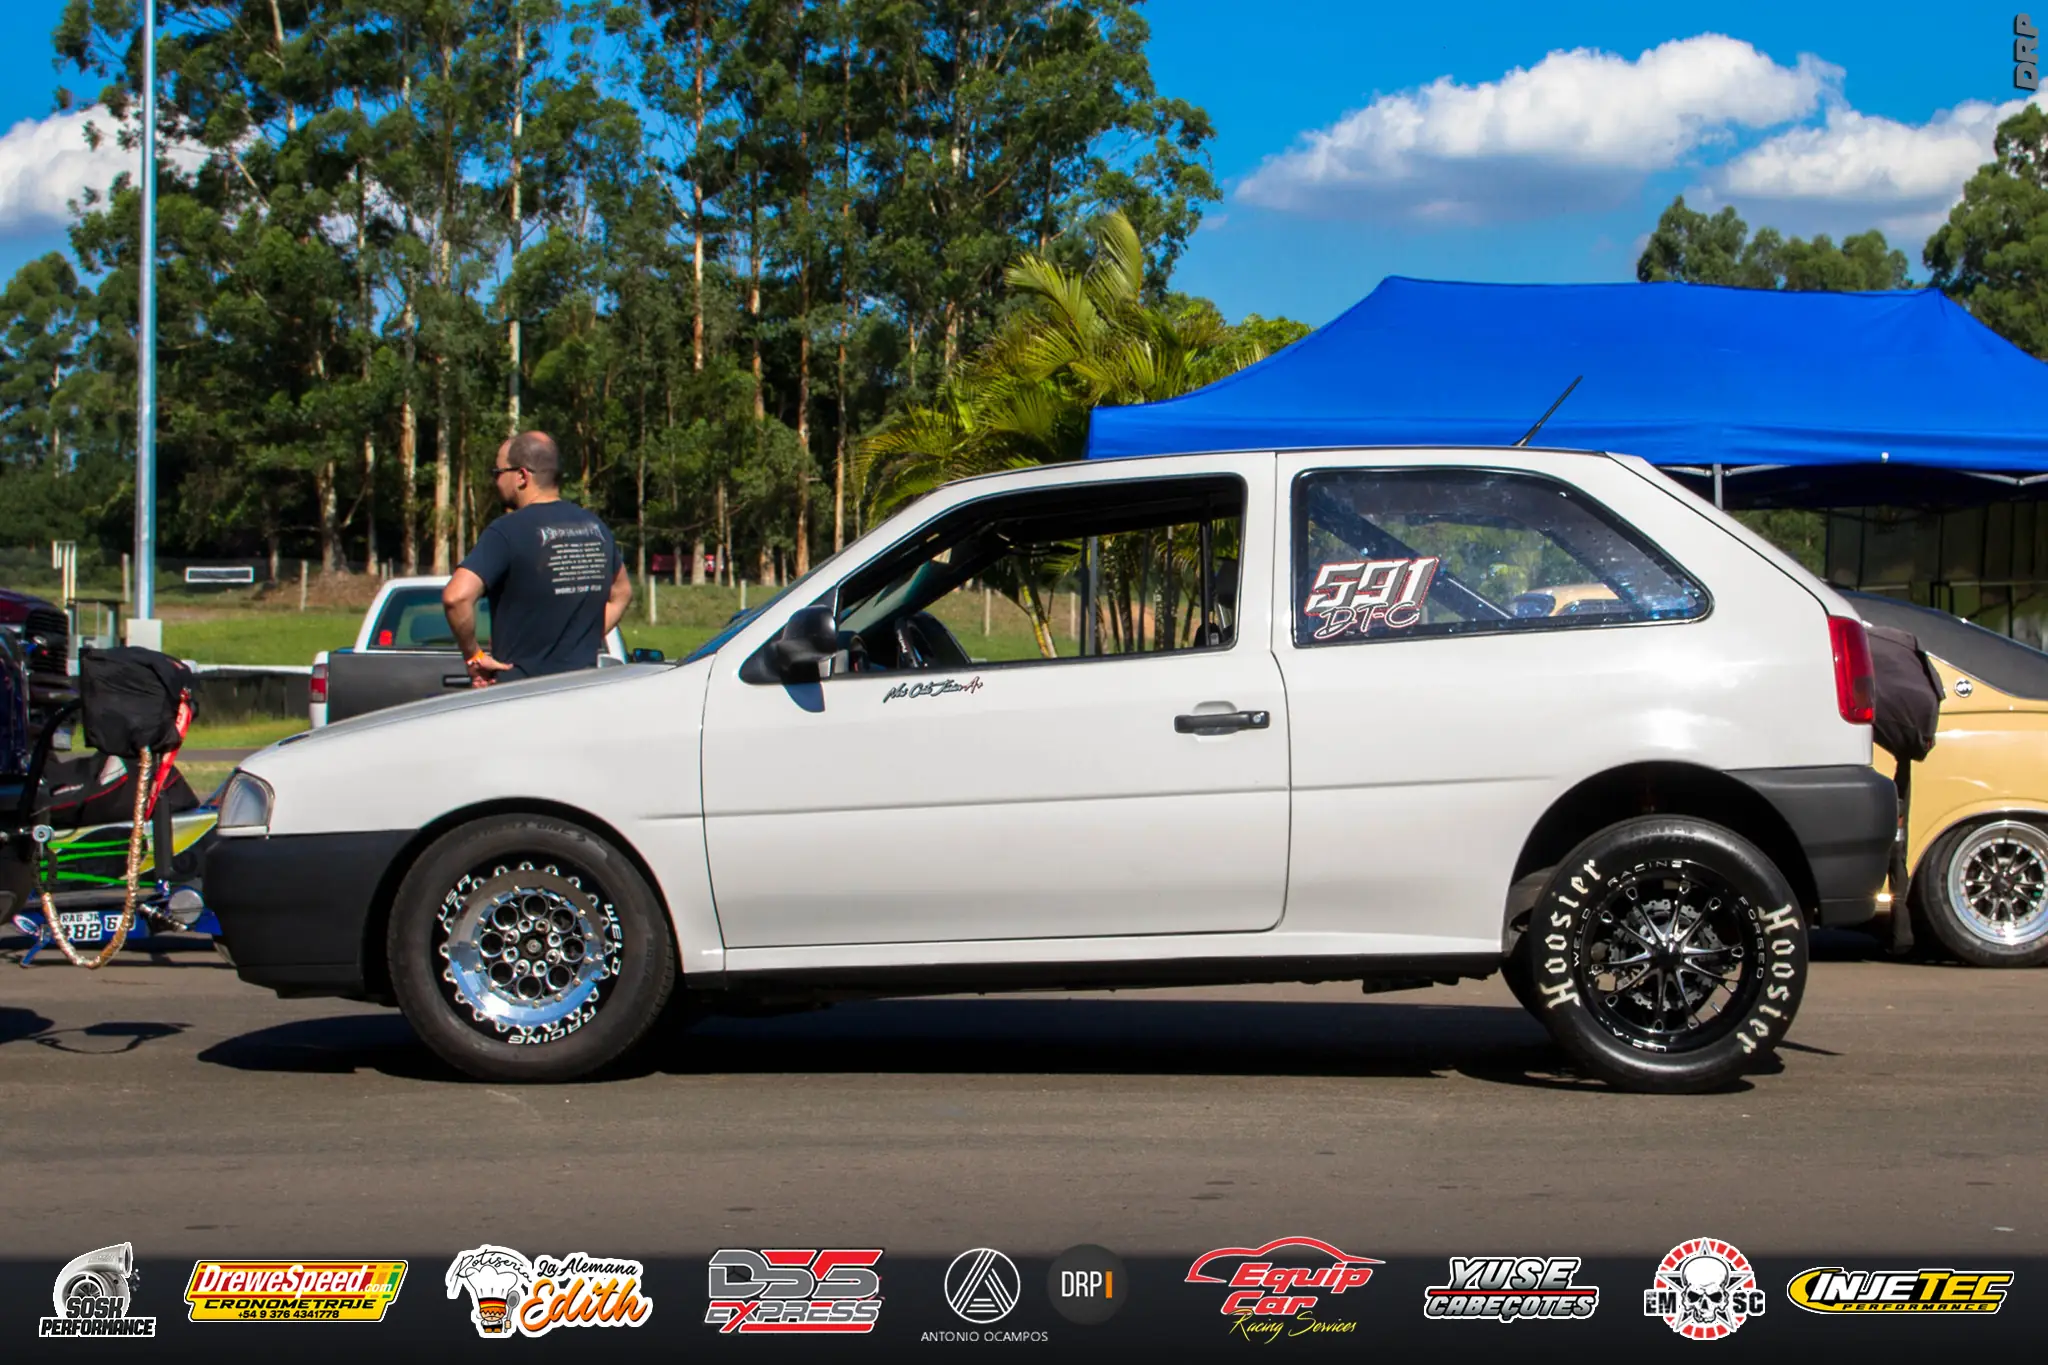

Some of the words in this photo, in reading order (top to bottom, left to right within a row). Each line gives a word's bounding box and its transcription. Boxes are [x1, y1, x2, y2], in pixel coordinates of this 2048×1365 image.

[1305, 556, 1430, 616] 591
[436, 874, 471, 922] USA
[604, 903, 624, 976] WELD
[1540, 859, 1601, 1009] Hoosier
[1573, 907, 1591, 967] WELD
[1736, 903, 1800, 1054] Hoosier
[507, 1005, 598, 1045] RACING
